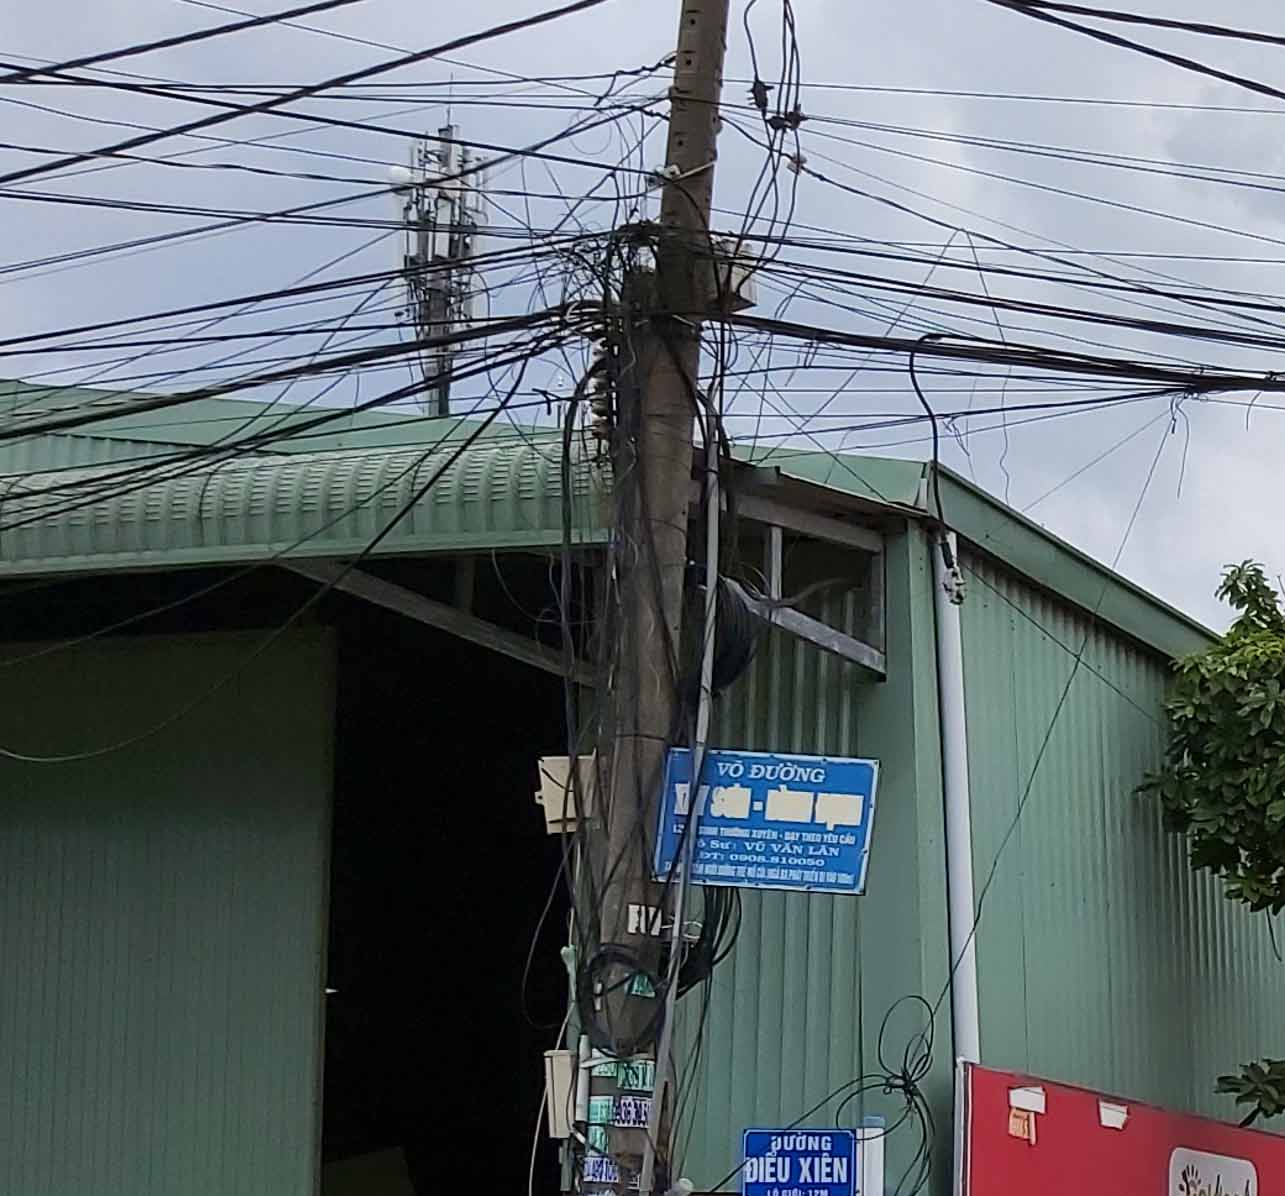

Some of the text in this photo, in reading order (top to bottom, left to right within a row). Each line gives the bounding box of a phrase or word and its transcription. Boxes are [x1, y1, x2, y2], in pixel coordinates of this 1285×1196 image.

[717, 762, 825, 783] VÕ ĐƯỜNG
[771, 1131, 832, 1151] ĐƯỜNG
